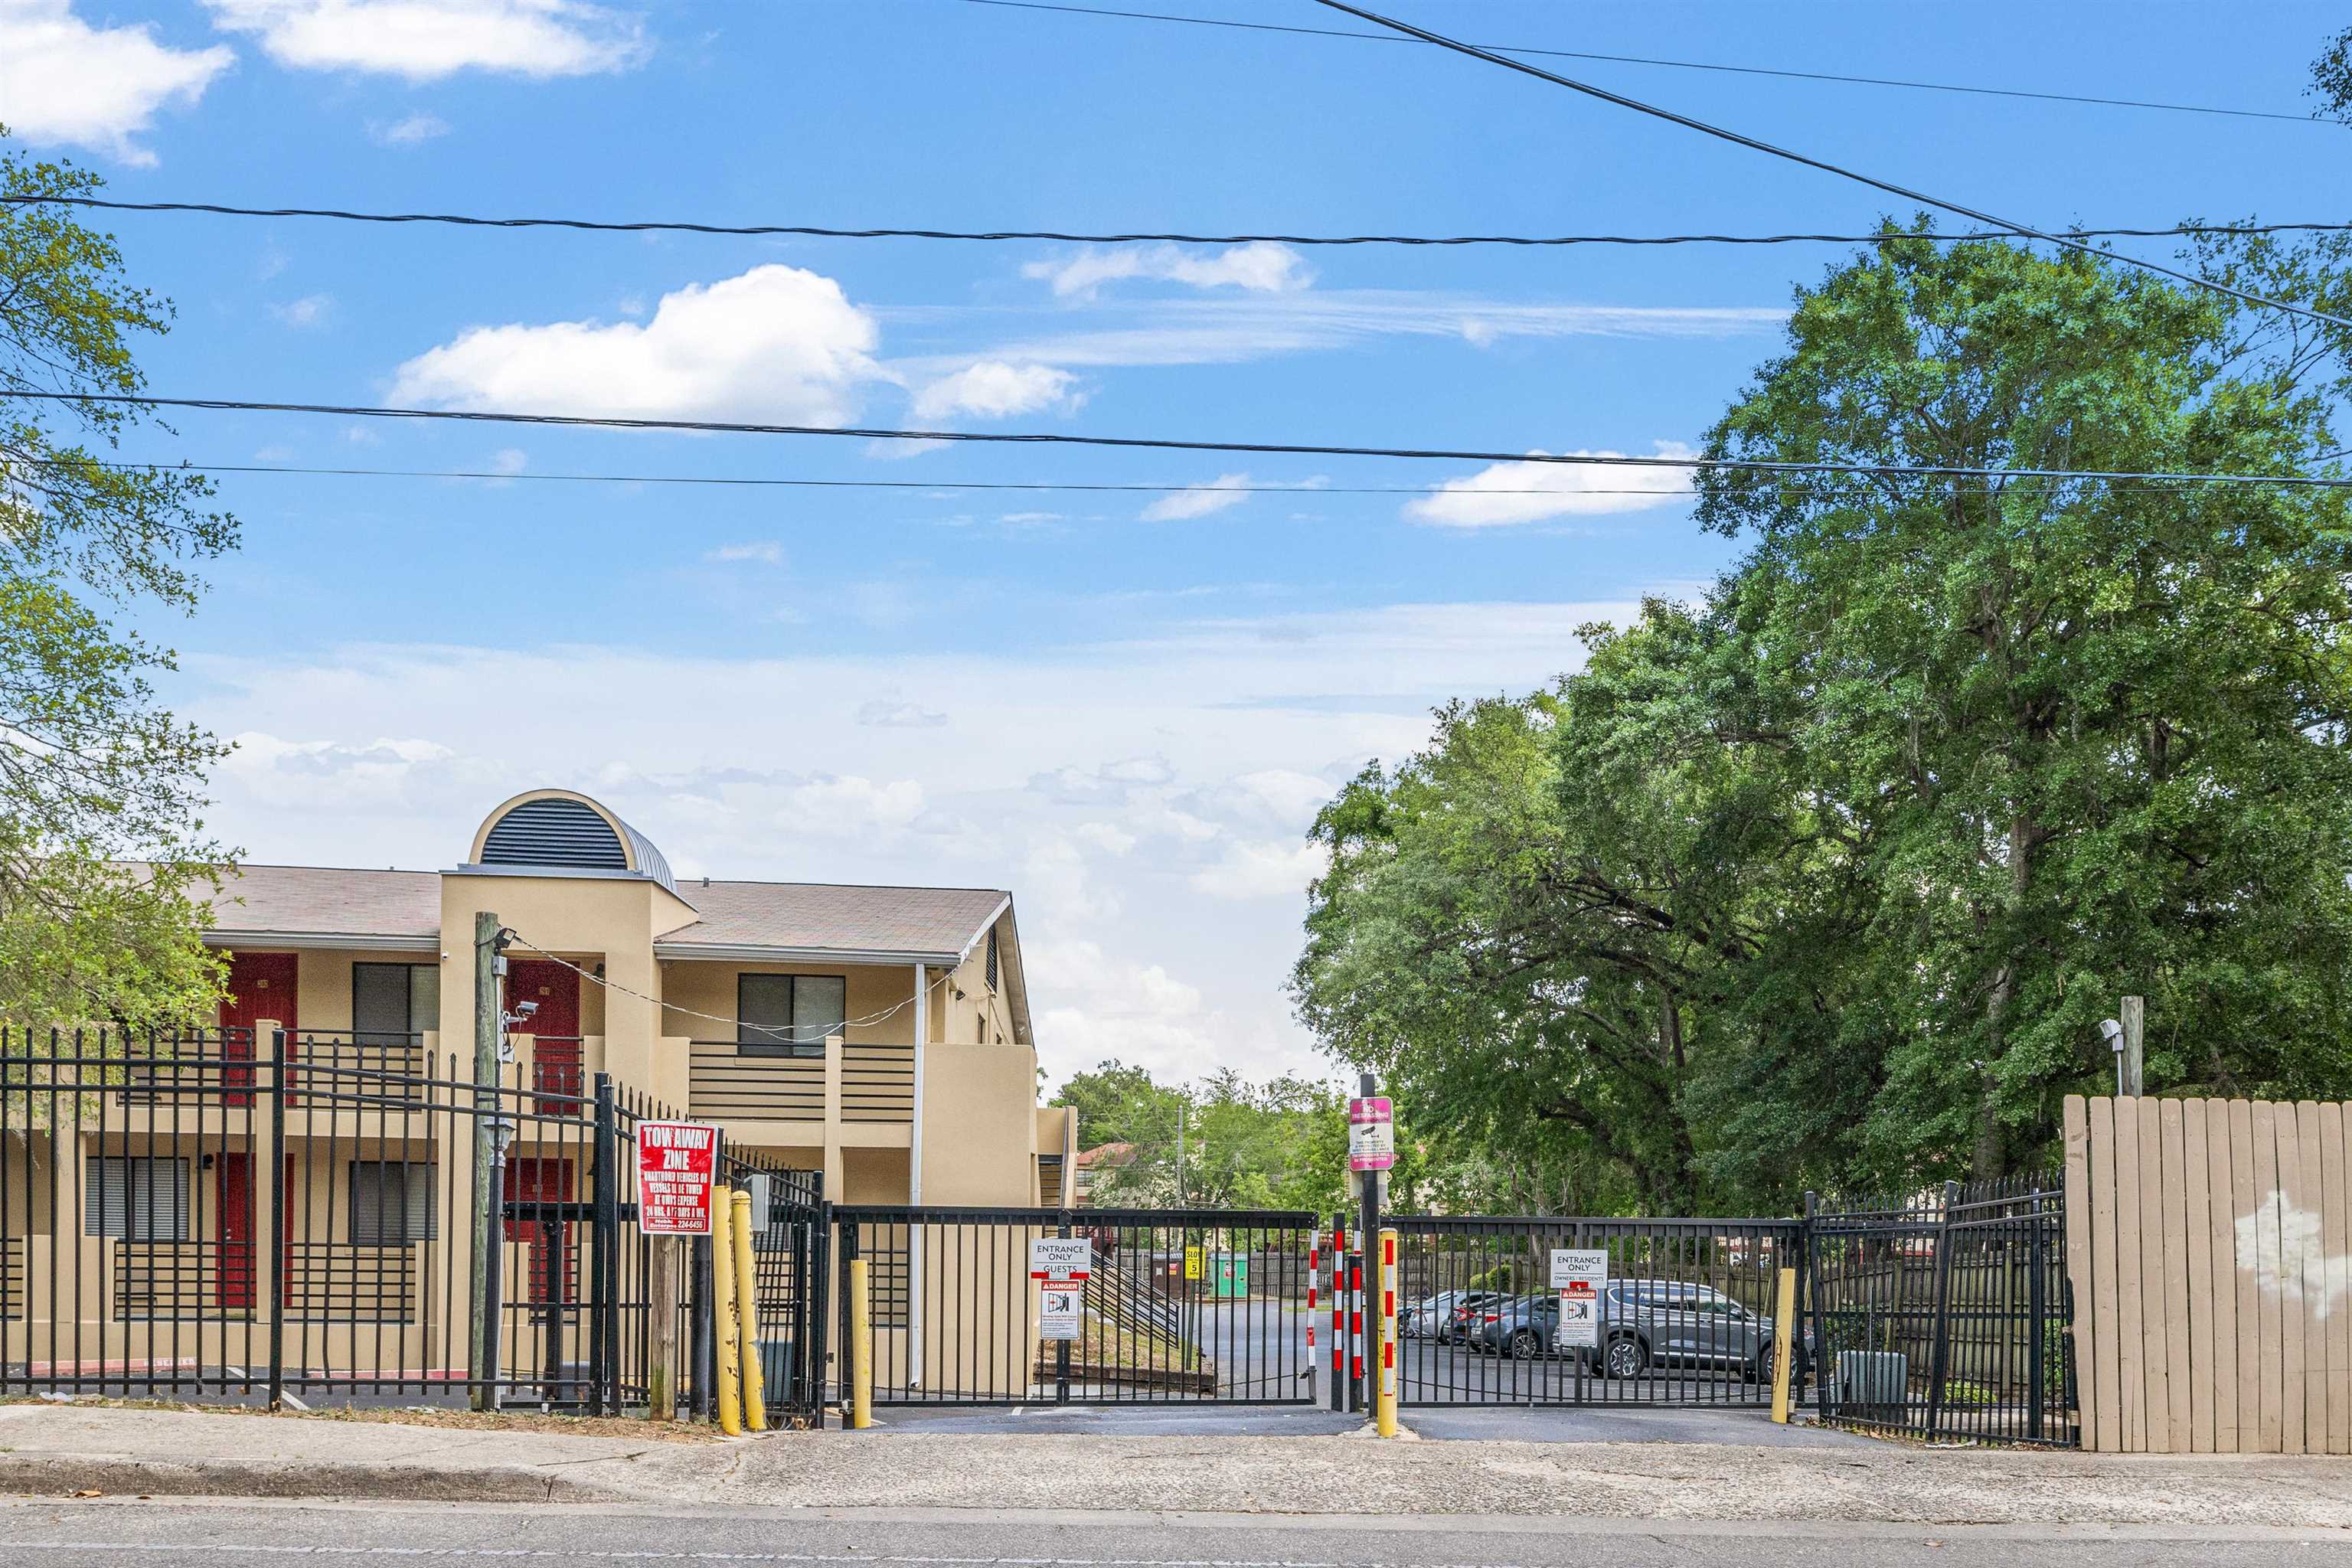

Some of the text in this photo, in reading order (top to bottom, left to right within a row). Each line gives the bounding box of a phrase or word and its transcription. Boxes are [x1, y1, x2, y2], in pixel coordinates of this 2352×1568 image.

[644, 1126, 711, 1150] TOW AWAY
[677, 1172, 699, 1183] VEHICLES
[701, 1173, 707, 1184] OR
[686, 1184, 703, 1195] TOWED
[678, 1195, 698, 1206] EXPENSE
[1037, 1245, 1084, 1253] ENTRANCE
[1044, 1265, 1077, 1273] GUESTS
